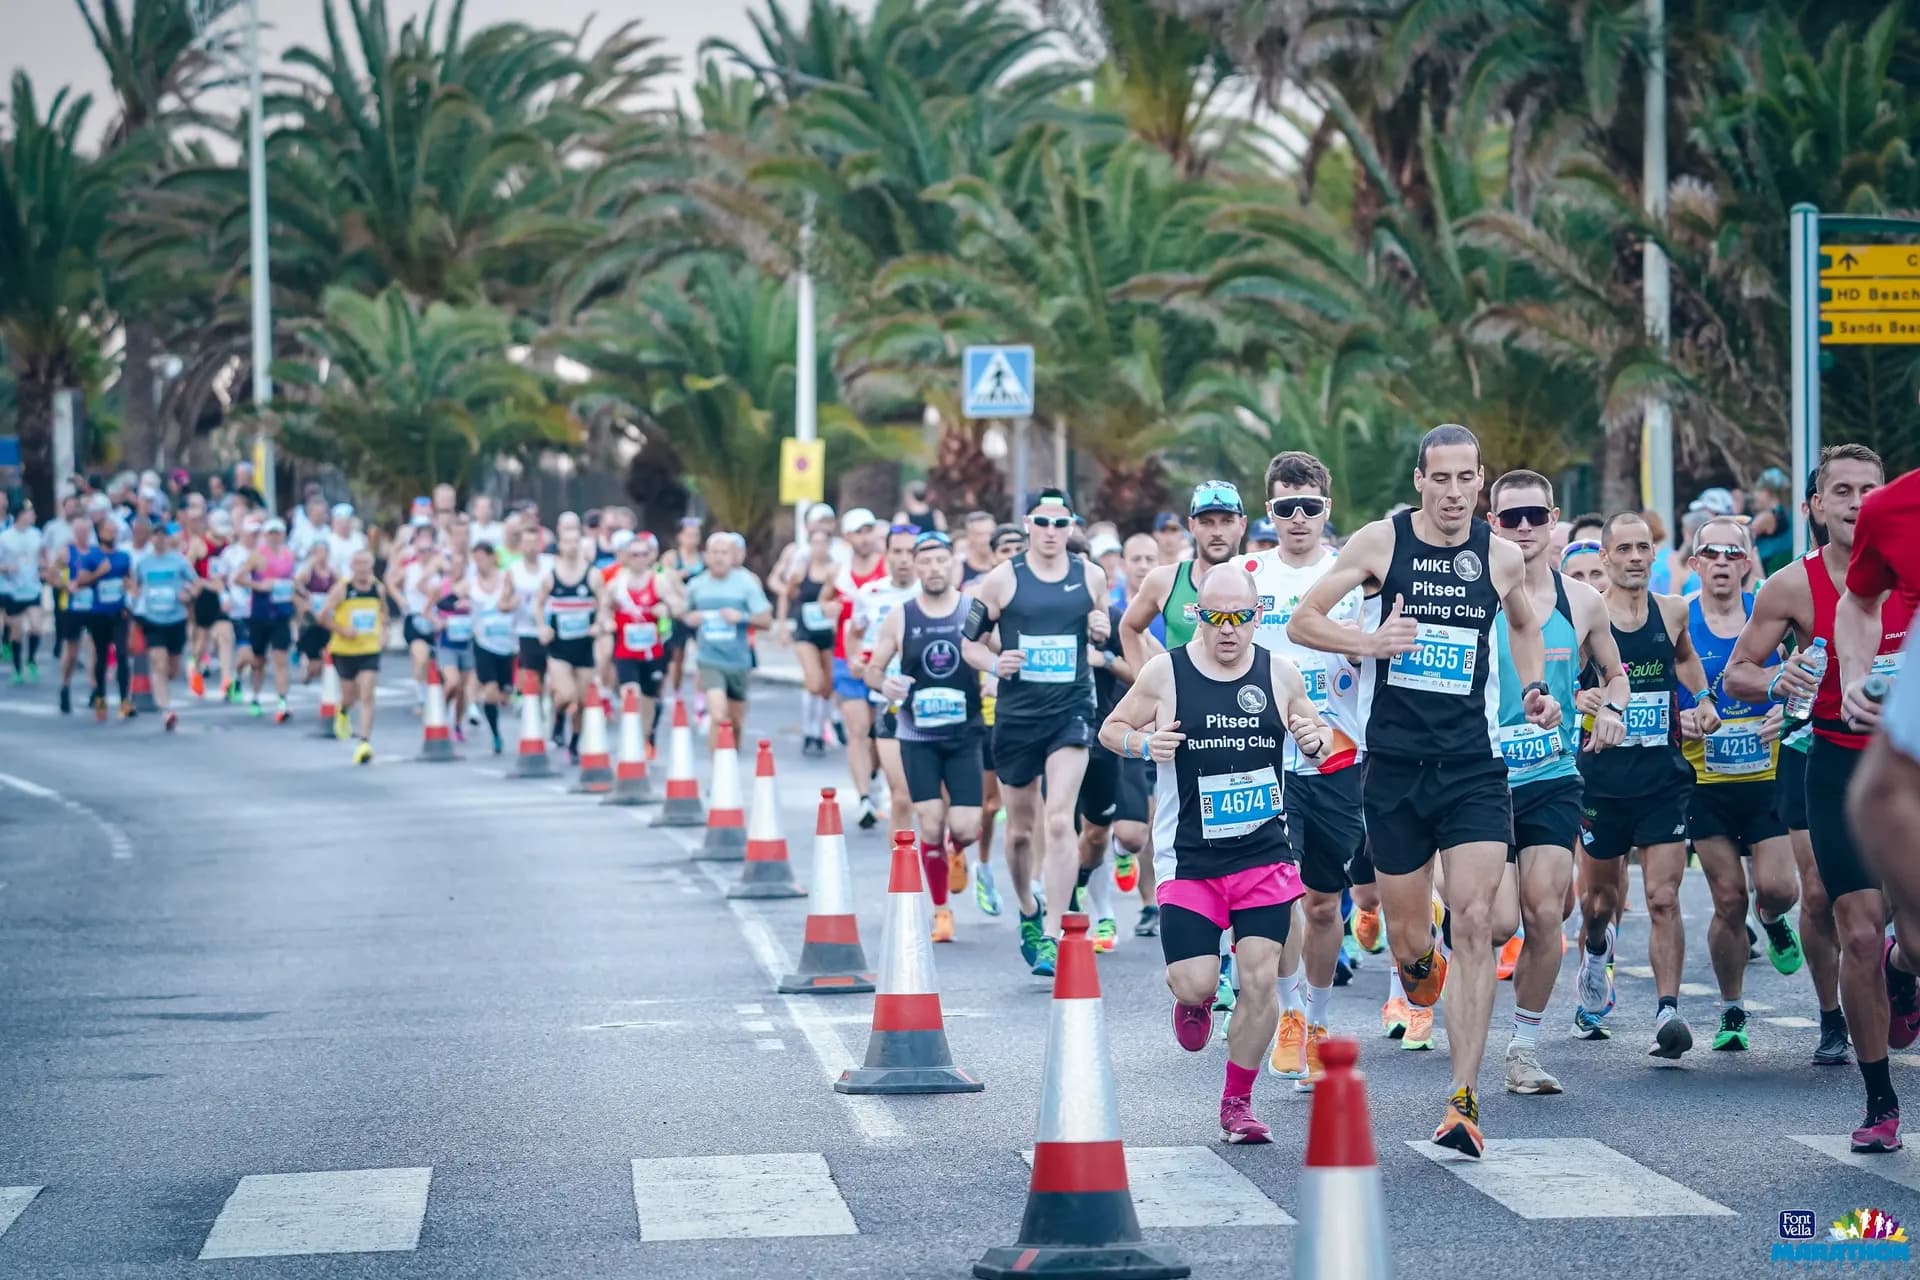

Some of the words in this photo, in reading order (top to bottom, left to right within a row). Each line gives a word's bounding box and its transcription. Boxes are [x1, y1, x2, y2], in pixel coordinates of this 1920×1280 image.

[1906, 254, 1920, 266] C
[1837, 288, 1860, 301] HD
[1840, 321, 1883, 334] Sands
[1412, 557, 1451, 574] MIKE
[1412, 581, 1466, 598] Pitsea
[1393, 602, 1451, 619] unning
[1454, 604, 1486, 619] Club
[1885, 631, 1907, 640] CRAFT
[1032, 650, 1066, 666] 4330
[1409, 643, 1459, 670] 4655
[1628, 659, 1664, 677] Saúde
[1206, 713, 1260, 729] Pitsea
[1187, 736, 1245, 751] Running
[1248, 735, 1276, 749] Club
[1506, 739, 1546, 761] 4129
[1720, 736, 1757, 756] 4215
[1220, 788, 1266, 815] 4674
